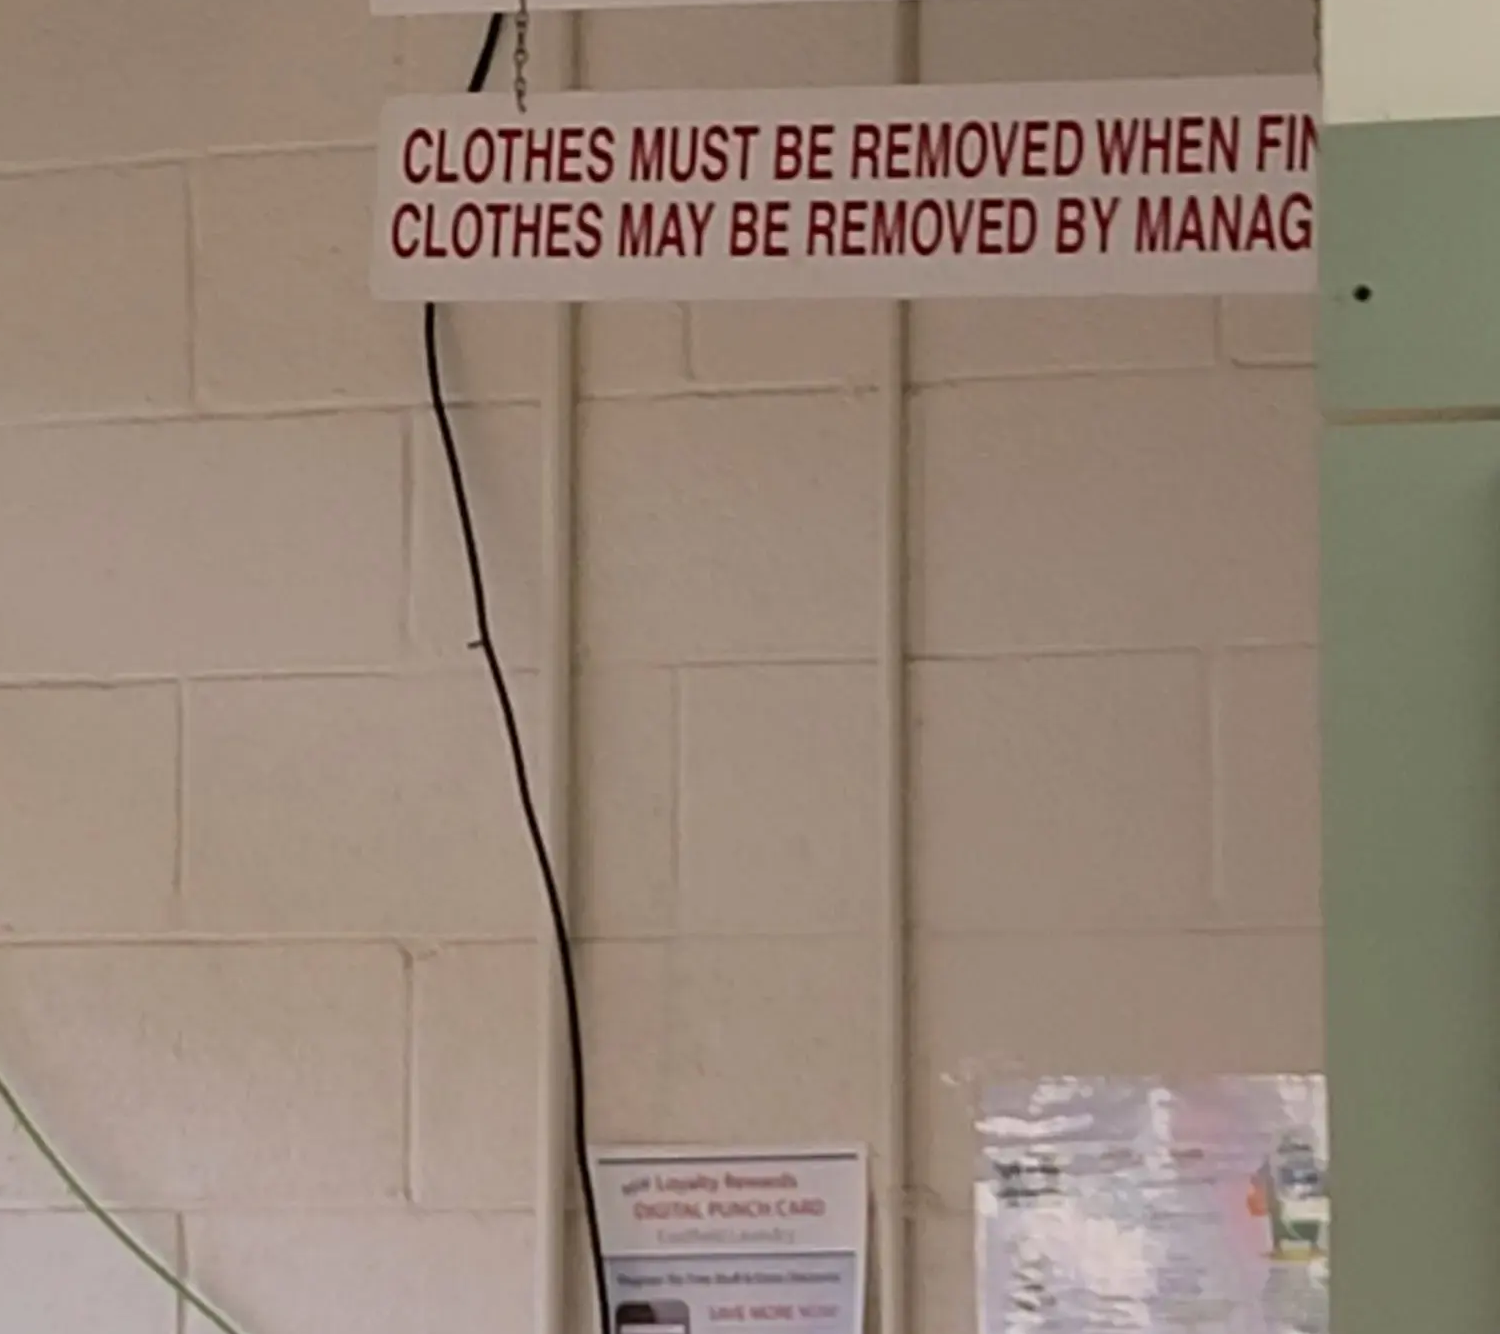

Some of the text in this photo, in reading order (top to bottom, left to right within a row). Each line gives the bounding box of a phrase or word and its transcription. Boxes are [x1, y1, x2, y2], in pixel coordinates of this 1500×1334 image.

[401, 125, 617, 187] CLOTHES
[629, 120, 761, 185] MUST
[770, 120, 835, 183] BE
[848, 117, 1084, 182] REMOVED
[1096, 113, 1242, 177] WHEN
[390, 189, 1314, 261] CLOTHES MAY BE REMOVED BY MANAG
[632, 1197, 827, 1220] DIGITAL PUNCH CARD
